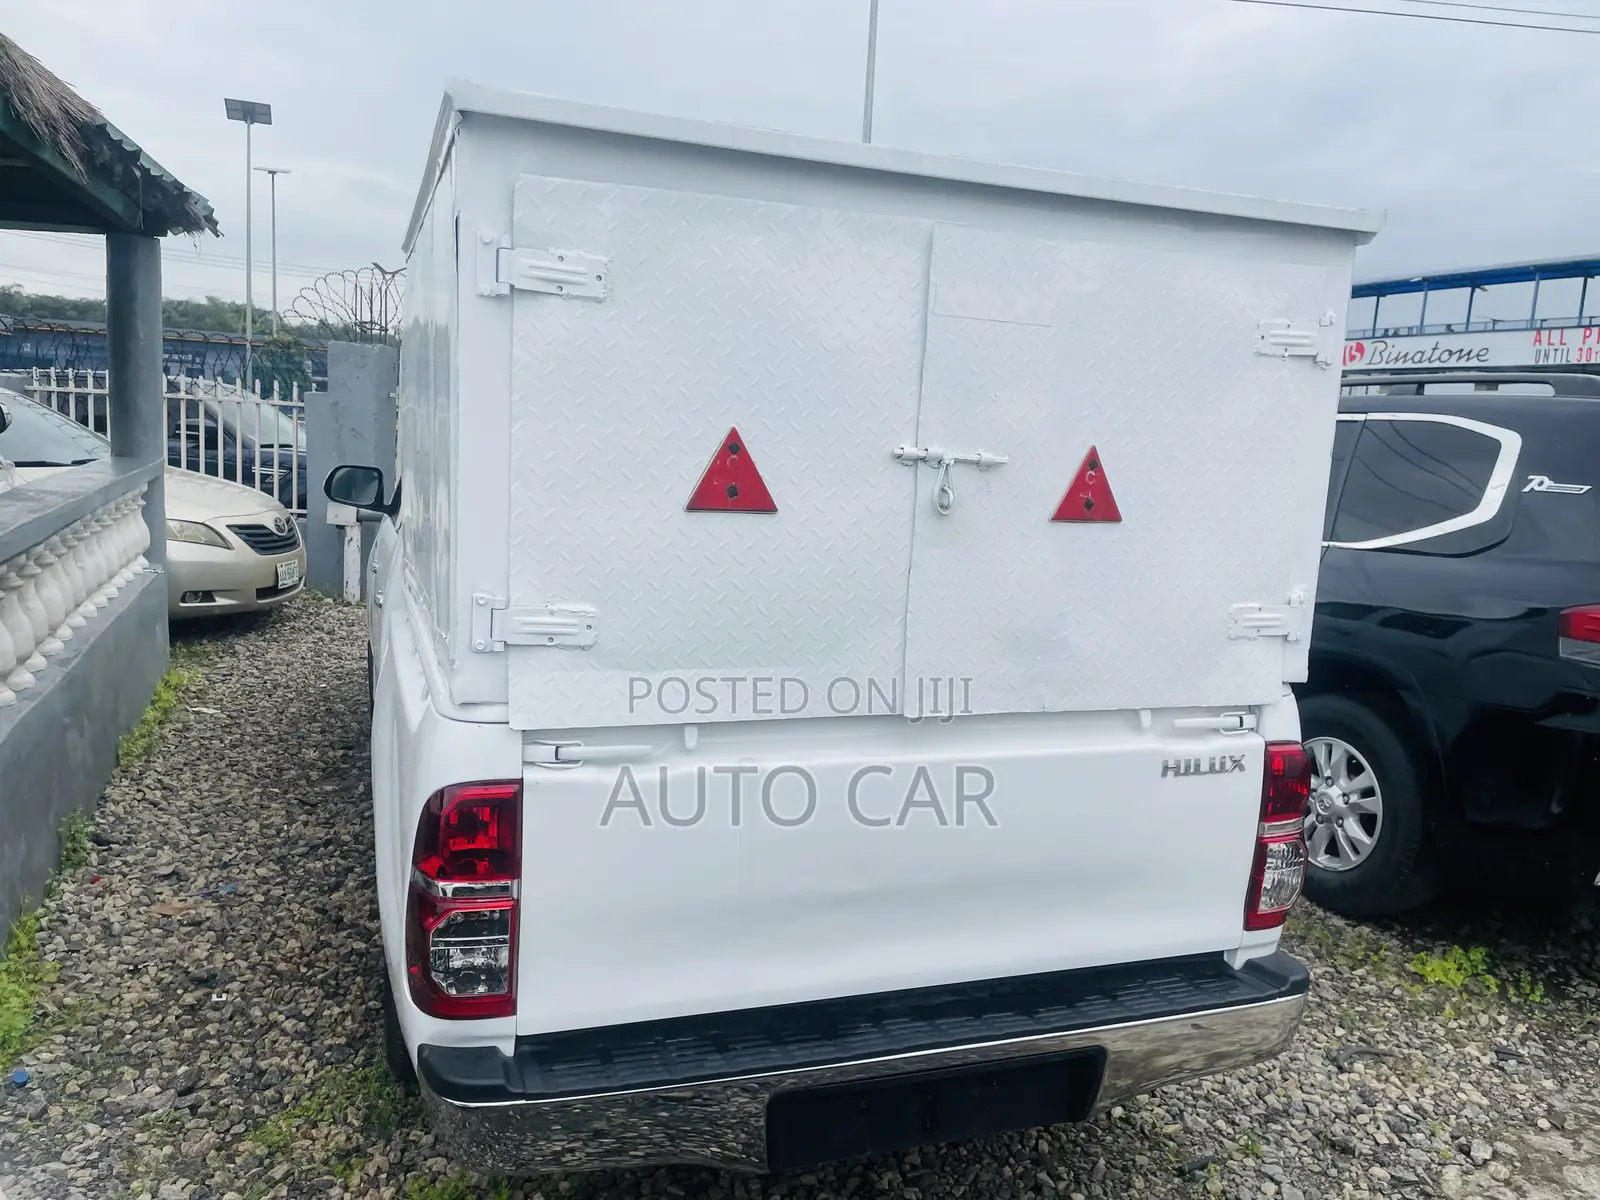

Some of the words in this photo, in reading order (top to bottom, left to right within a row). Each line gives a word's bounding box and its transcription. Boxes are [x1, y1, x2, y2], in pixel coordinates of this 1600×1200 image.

[1533, 328, 1567, 346] ALL
[1365, 340, 1489, 365] Binatone
[1534, 348, 1571, 363] UNTIL
[1160, 753, 1246, 778] HILUX
